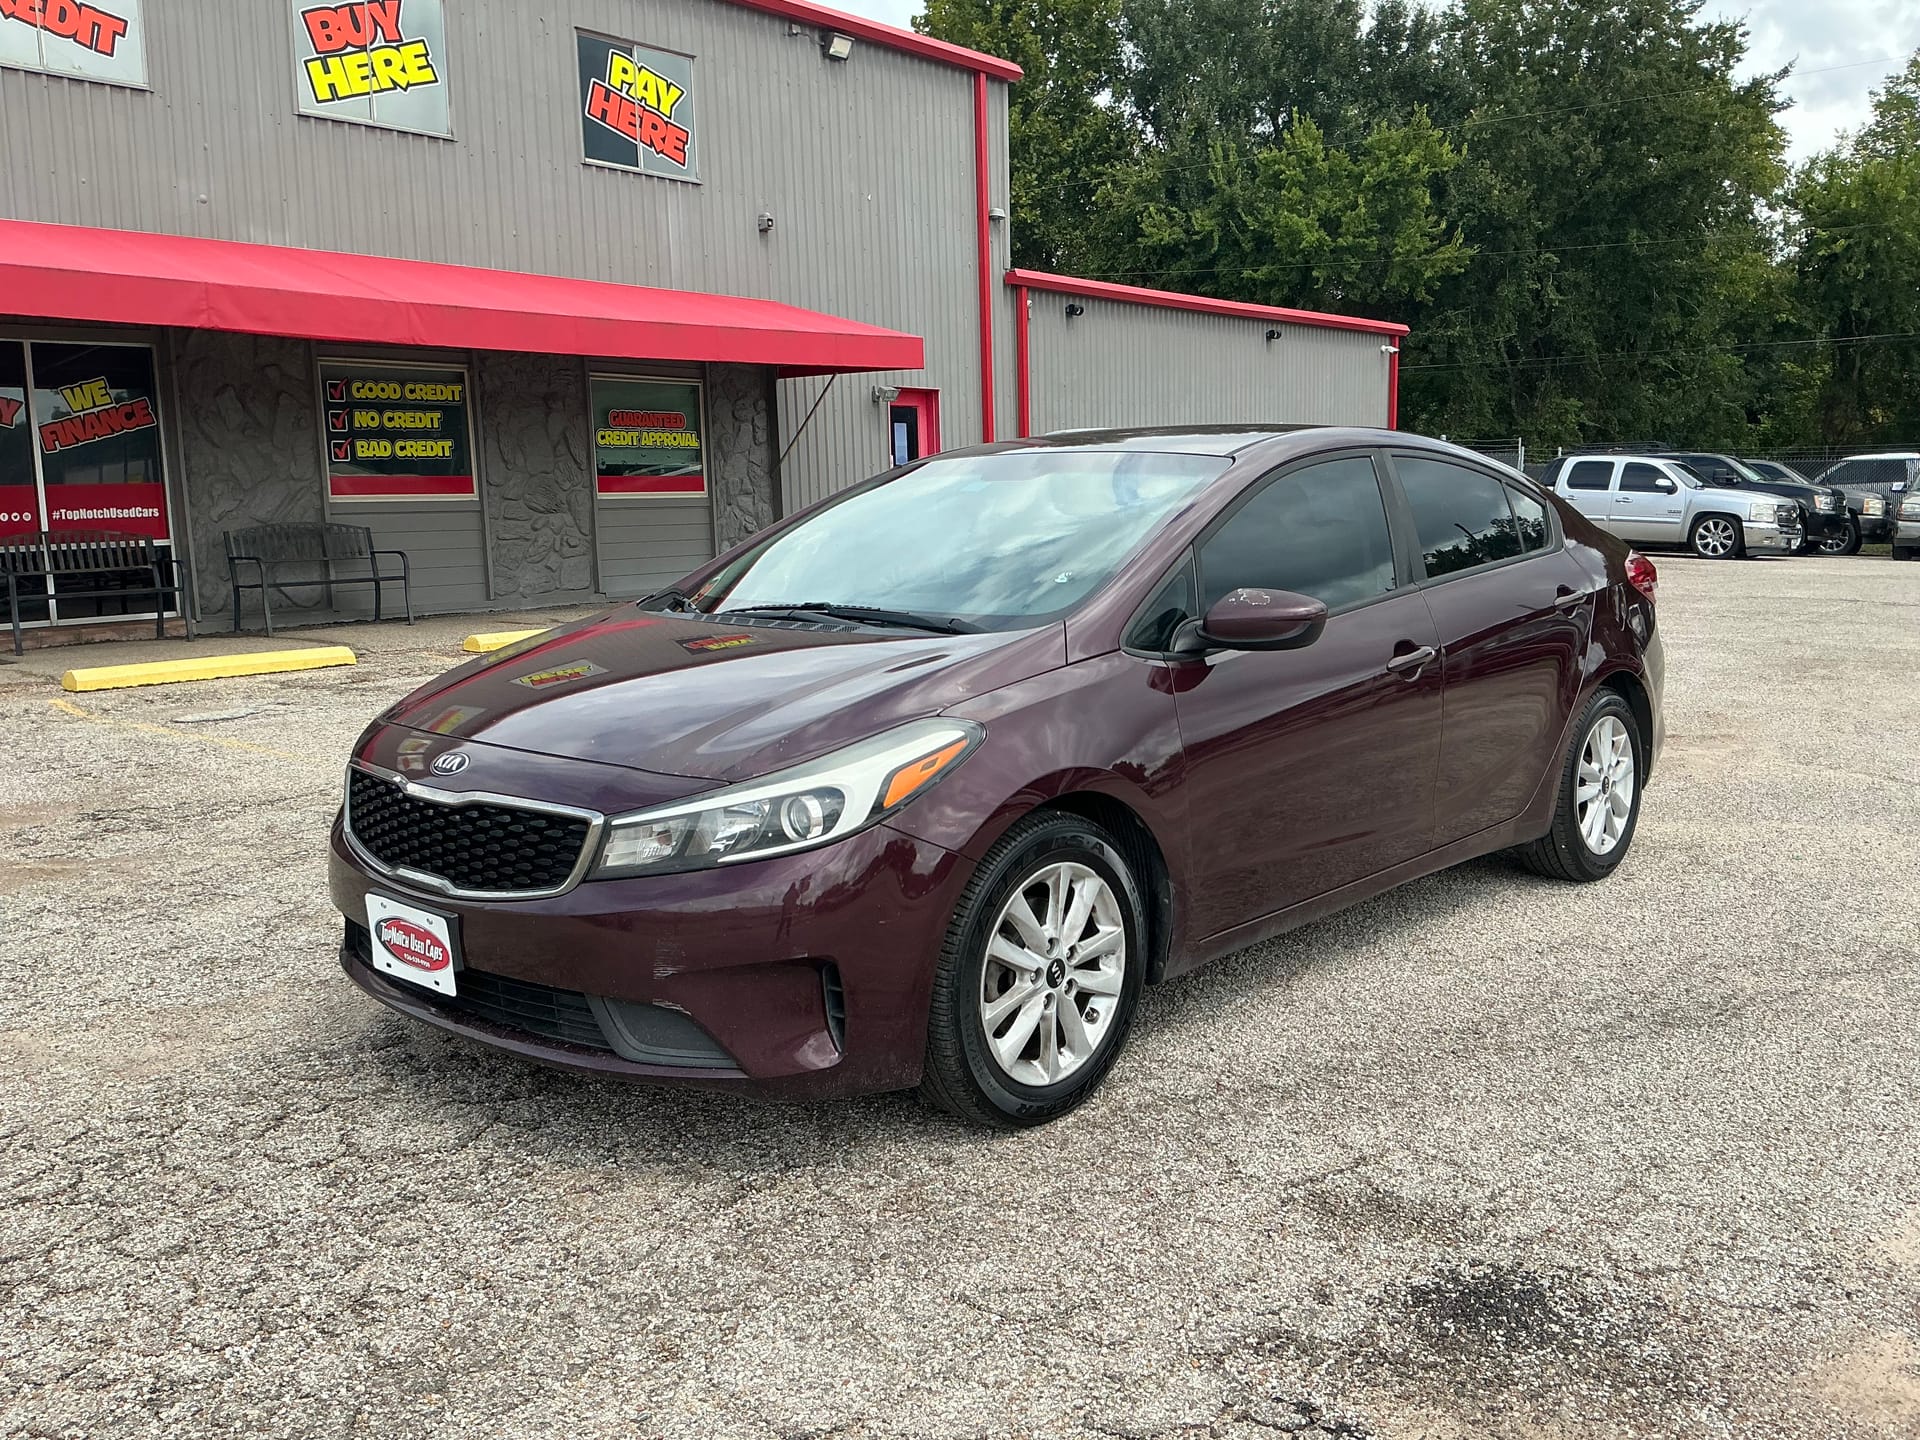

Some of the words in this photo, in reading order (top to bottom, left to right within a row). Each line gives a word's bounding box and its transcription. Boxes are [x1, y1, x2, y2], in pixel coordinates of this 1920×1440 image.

[301, 0, 402, 54] BUY
[304, 39, 438, 103] HERE
[608, 52, 685, 119] PAY
[587, 81, 688, 166] HERE
[60, 379, 113, 413] WE
[351, 381, 401, 400] GOOD
[404, 384, 462, 402] CREDIT
[39, 399, 155, 452] FINANCE
[354, 411, 380, 428] NO
[383, 412, 441, 429] CREDIT
[610, 410, 686, 428] GUARANTEED
[356, 440, 392, 457] BAD
[395, 441, 452, 458] CREDIT
[597, 430, 638, 446] CREDIT
[641, 431, 699, 447] APPROVAL
[52, 507, 159, 521] #TopNotchUsedCars
[434, 754, 463, 771] KIA
